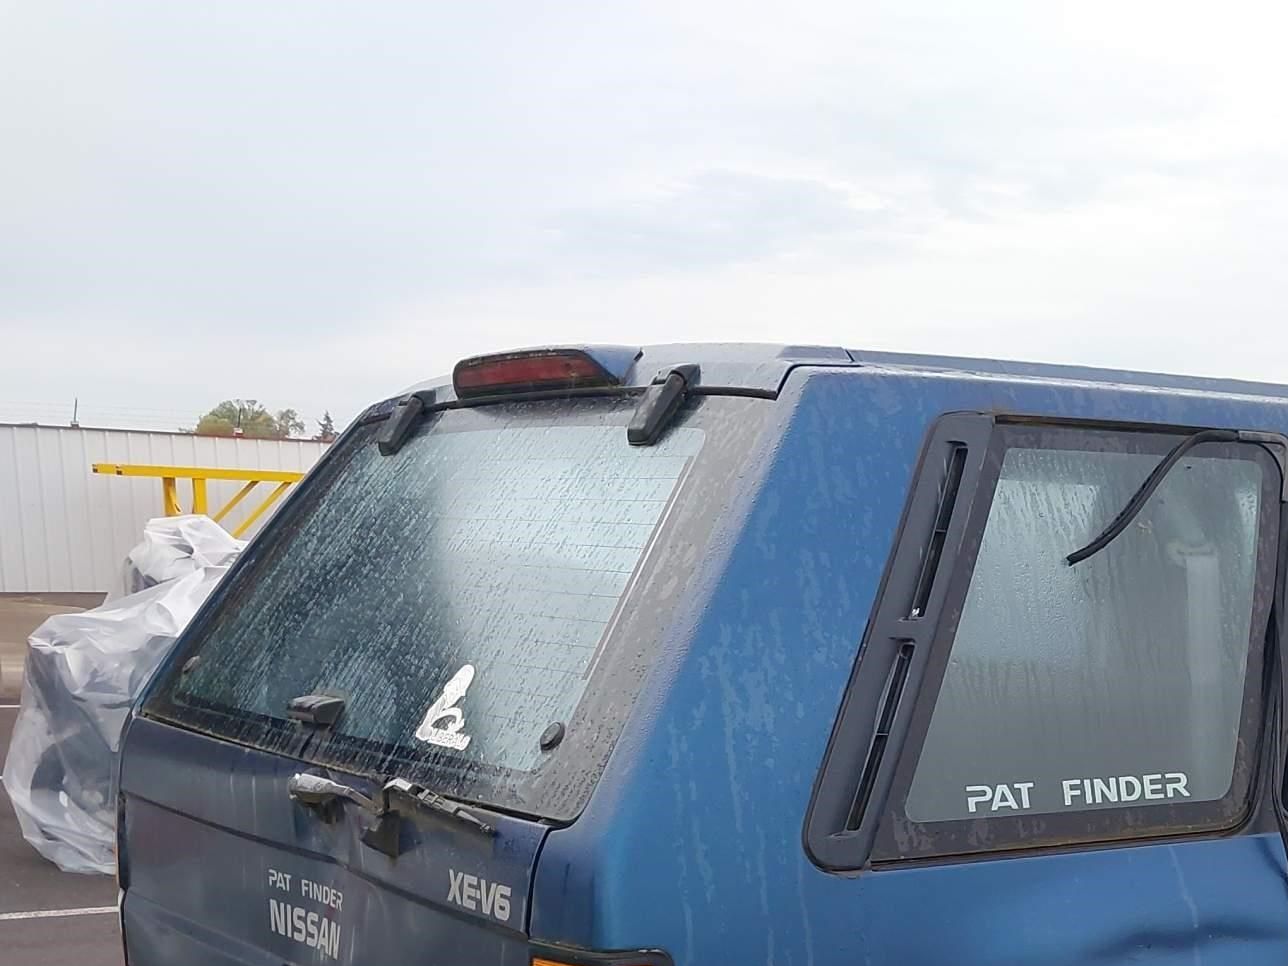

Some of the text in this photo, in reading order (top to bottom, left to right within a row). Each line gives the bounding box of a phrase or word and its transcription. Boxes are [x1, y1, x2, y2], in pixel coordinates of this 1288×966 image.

[965, 772, 1191, 813] PAT FINDER
[268, 868, 343, 912] PAT FINDER
[269, 898, 341, 961] NISSAN
